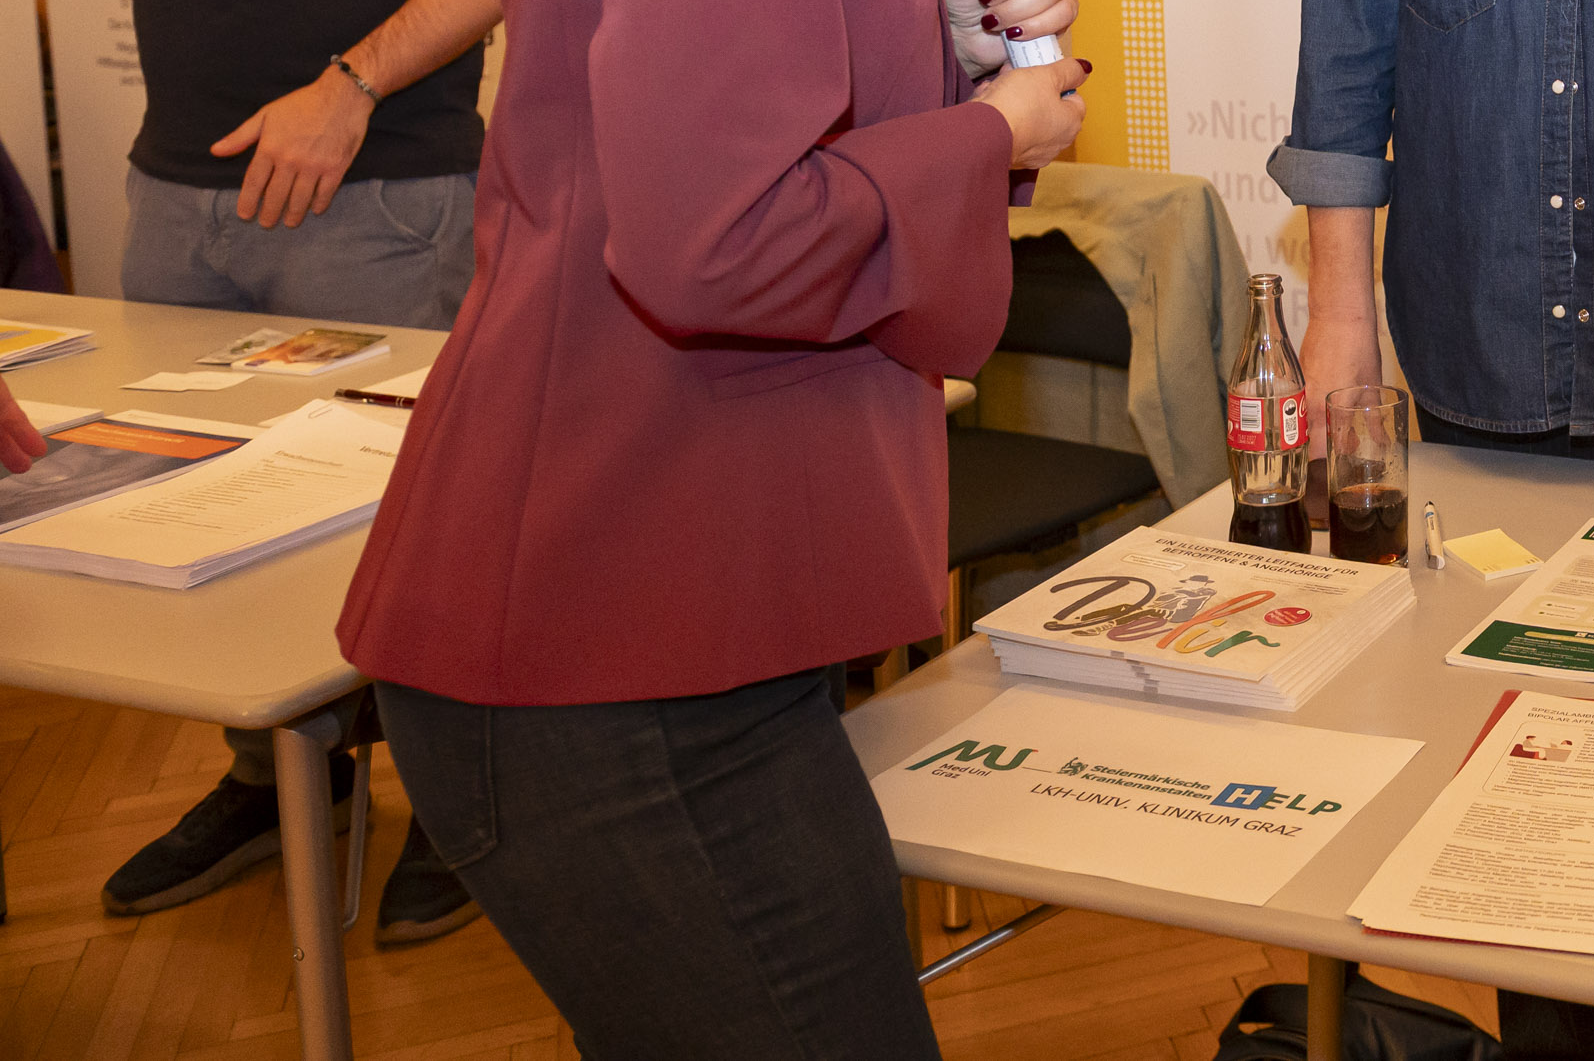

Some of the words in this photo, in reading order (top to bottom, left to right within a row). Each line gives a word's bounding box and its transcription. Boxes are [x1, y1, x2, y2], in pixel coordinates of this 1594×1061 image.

[1162, 547, 1237, 564] BETROFFENE
[1251, 563, 1331, 579] ANGEHÖRIGE
[1179, 543, 1264, 562] ILLUSTRIERTER
[1266, 555, 1332, 571] LEITFADEN
[1333, 567, 1359, 576] FÜR
[1527, 712, 1571, 723] BIPOLAR
[932, 769, 961, 779] Graz
[1081, 773, 1212, 801] Krankenanstalten
[1090, 765, 1210, 790] Steiermärkische
[1030, 783, 1128, 809] LKH-UNIV.
[1136, 802, 1240, 827] KLINIKUM
[1243, 820, 1303, 837] GRAZ
[1226, 787, 1342, 815] HELP
